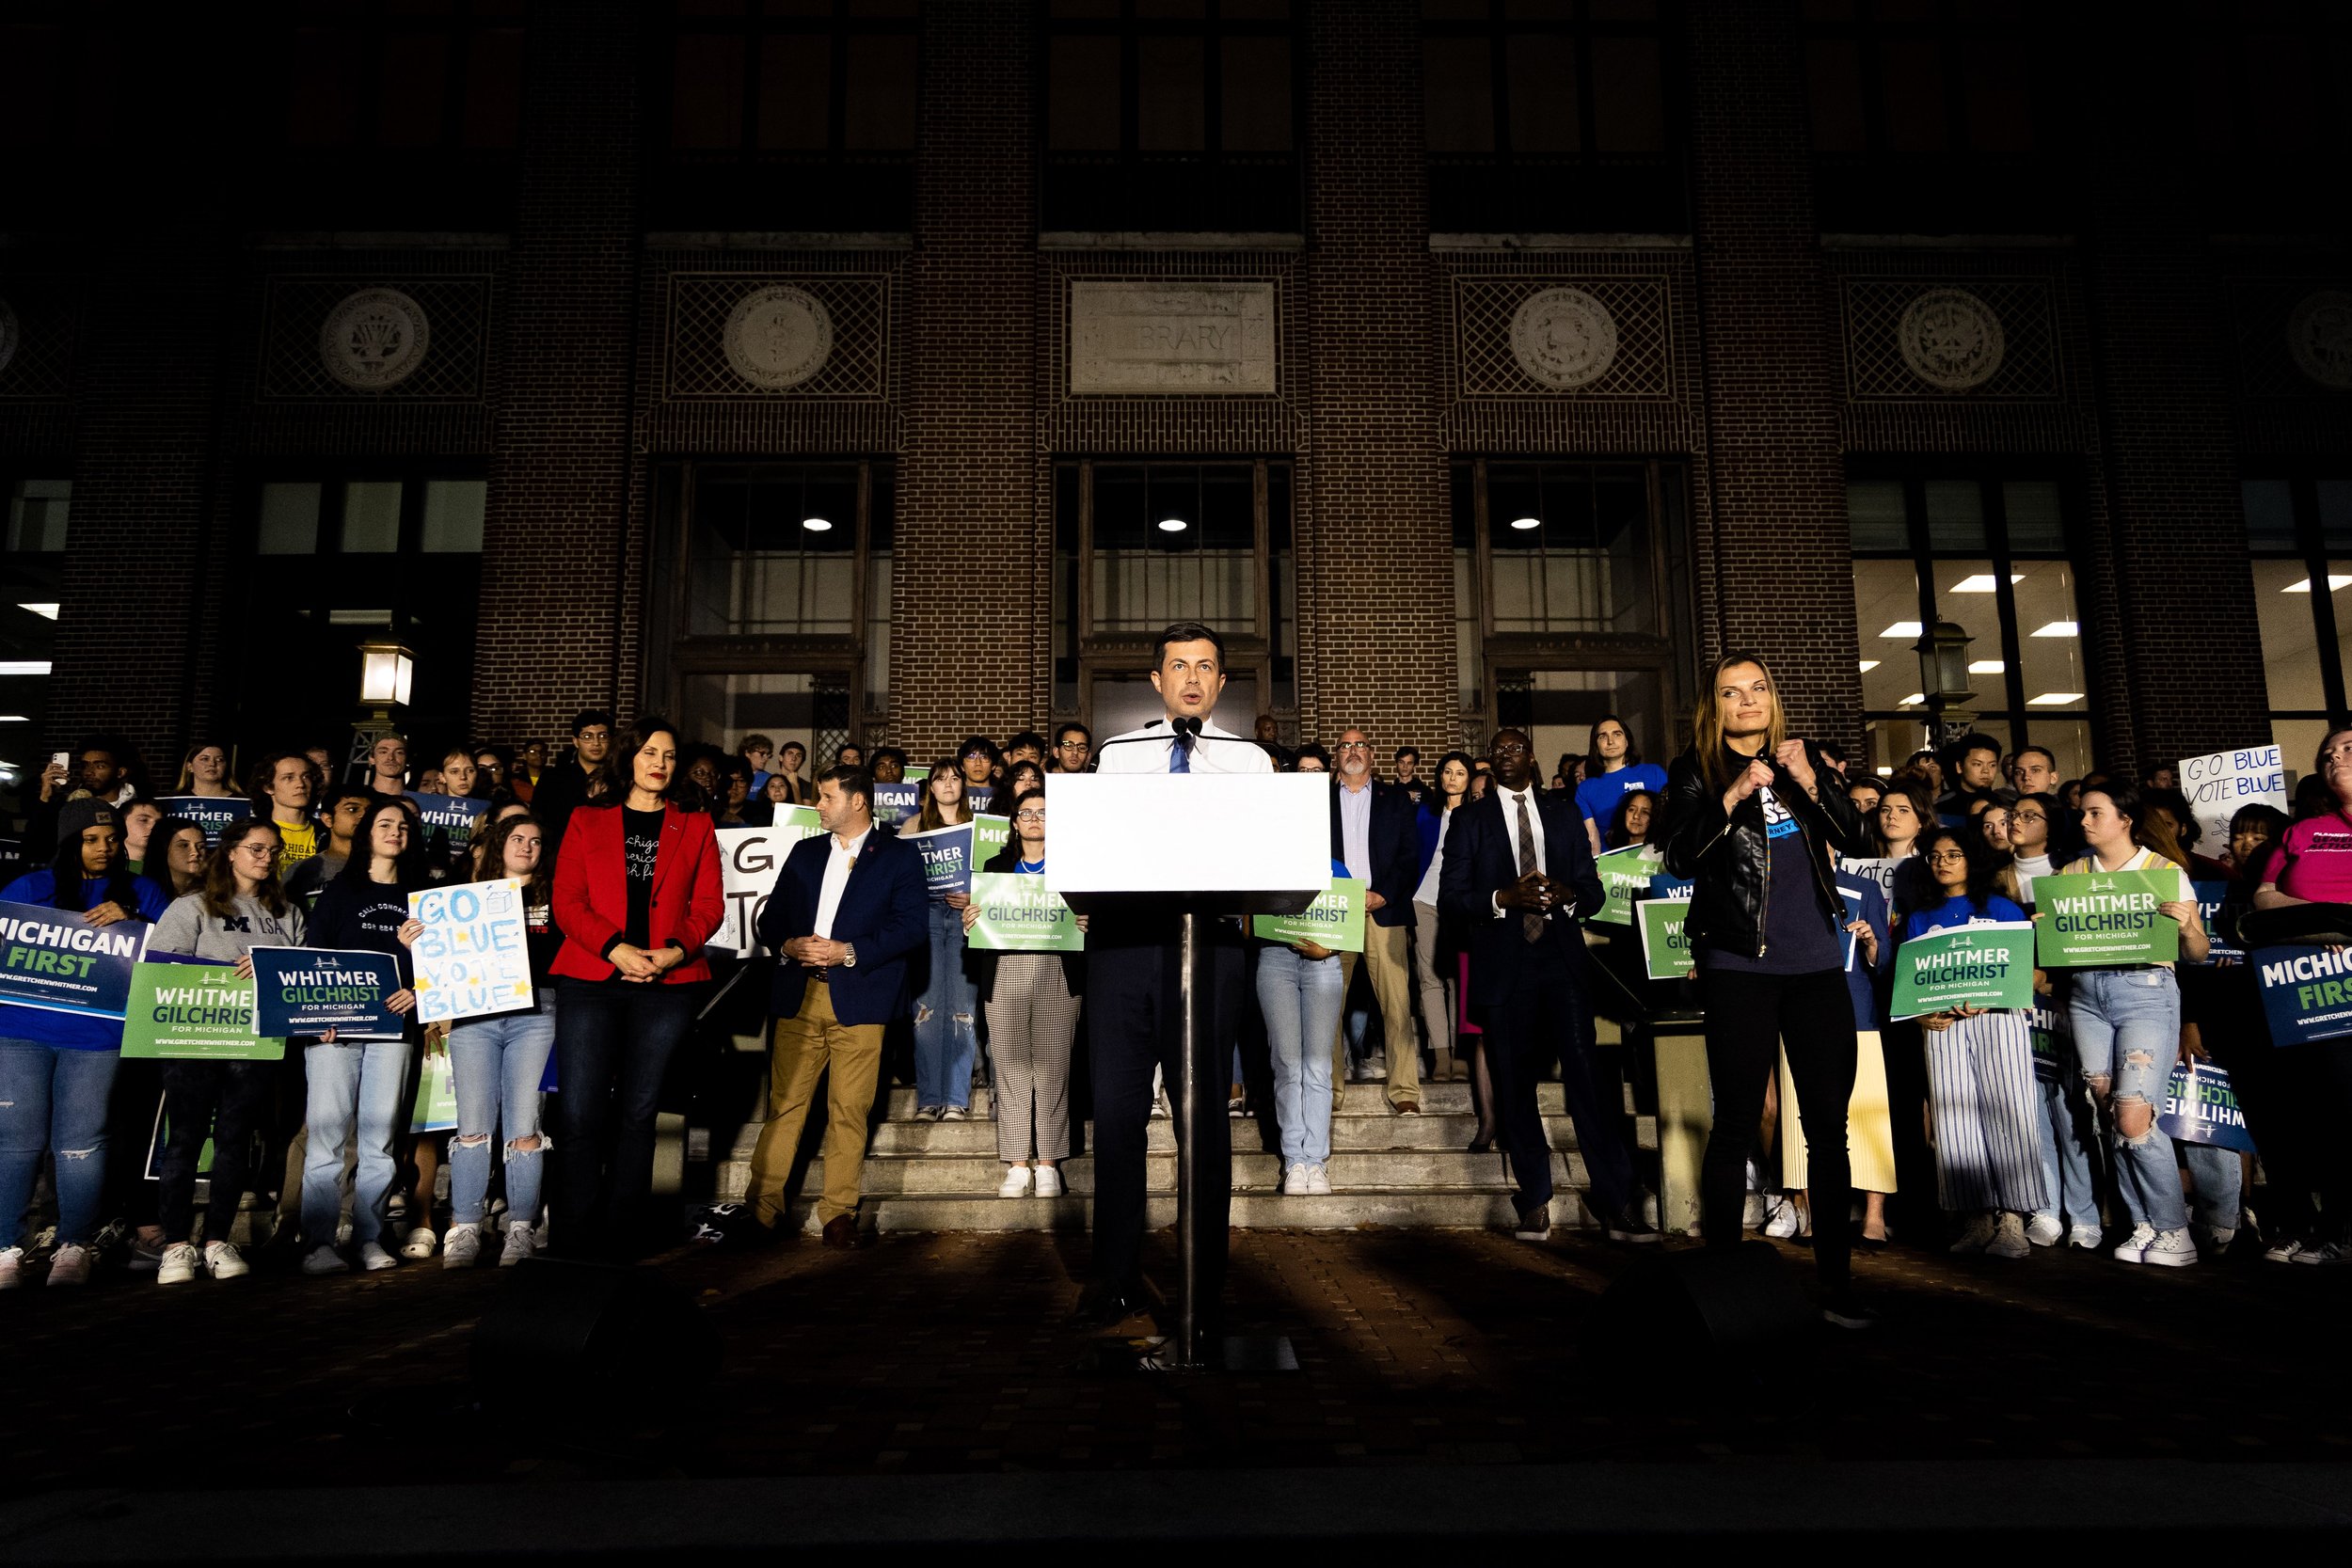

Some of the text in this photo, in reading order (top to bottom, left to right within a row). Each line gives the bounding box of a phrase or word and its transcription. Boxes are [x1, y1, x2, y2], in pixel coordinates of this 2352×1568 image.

[2187, 749, 2281, 780] GO BLUE
[2185, 773, 2287, 806] VOTE BLUE
[358, 905, 376, 918] CALL
[418, 888, 481, 925] GO
[2053, 893, 2158, 914] WHITMER
[223, 916, 283, 935] M LSA
[987, 907, 1068, 923] GILCHRIST
[2055, 911, 2157, 932] GILCHRIST
[418, 919, 518, 958] BLUE
[2095, 931, 2138, 940] MICHIGAN
[7, 946, 97, 978] FIRST
[423, 952, 519, 986] VOTE
[1915, 948, 2010, 971] WHITMER
[278, 971, 380, 987] WHITMER
[1914, 964, 2010, 986] GILCHRIST
[155, 987, 252, 1007] WHITME
[282, 987, 381, 1004] GILCHRIST
[422, 984, 520, 1019] BLUE
